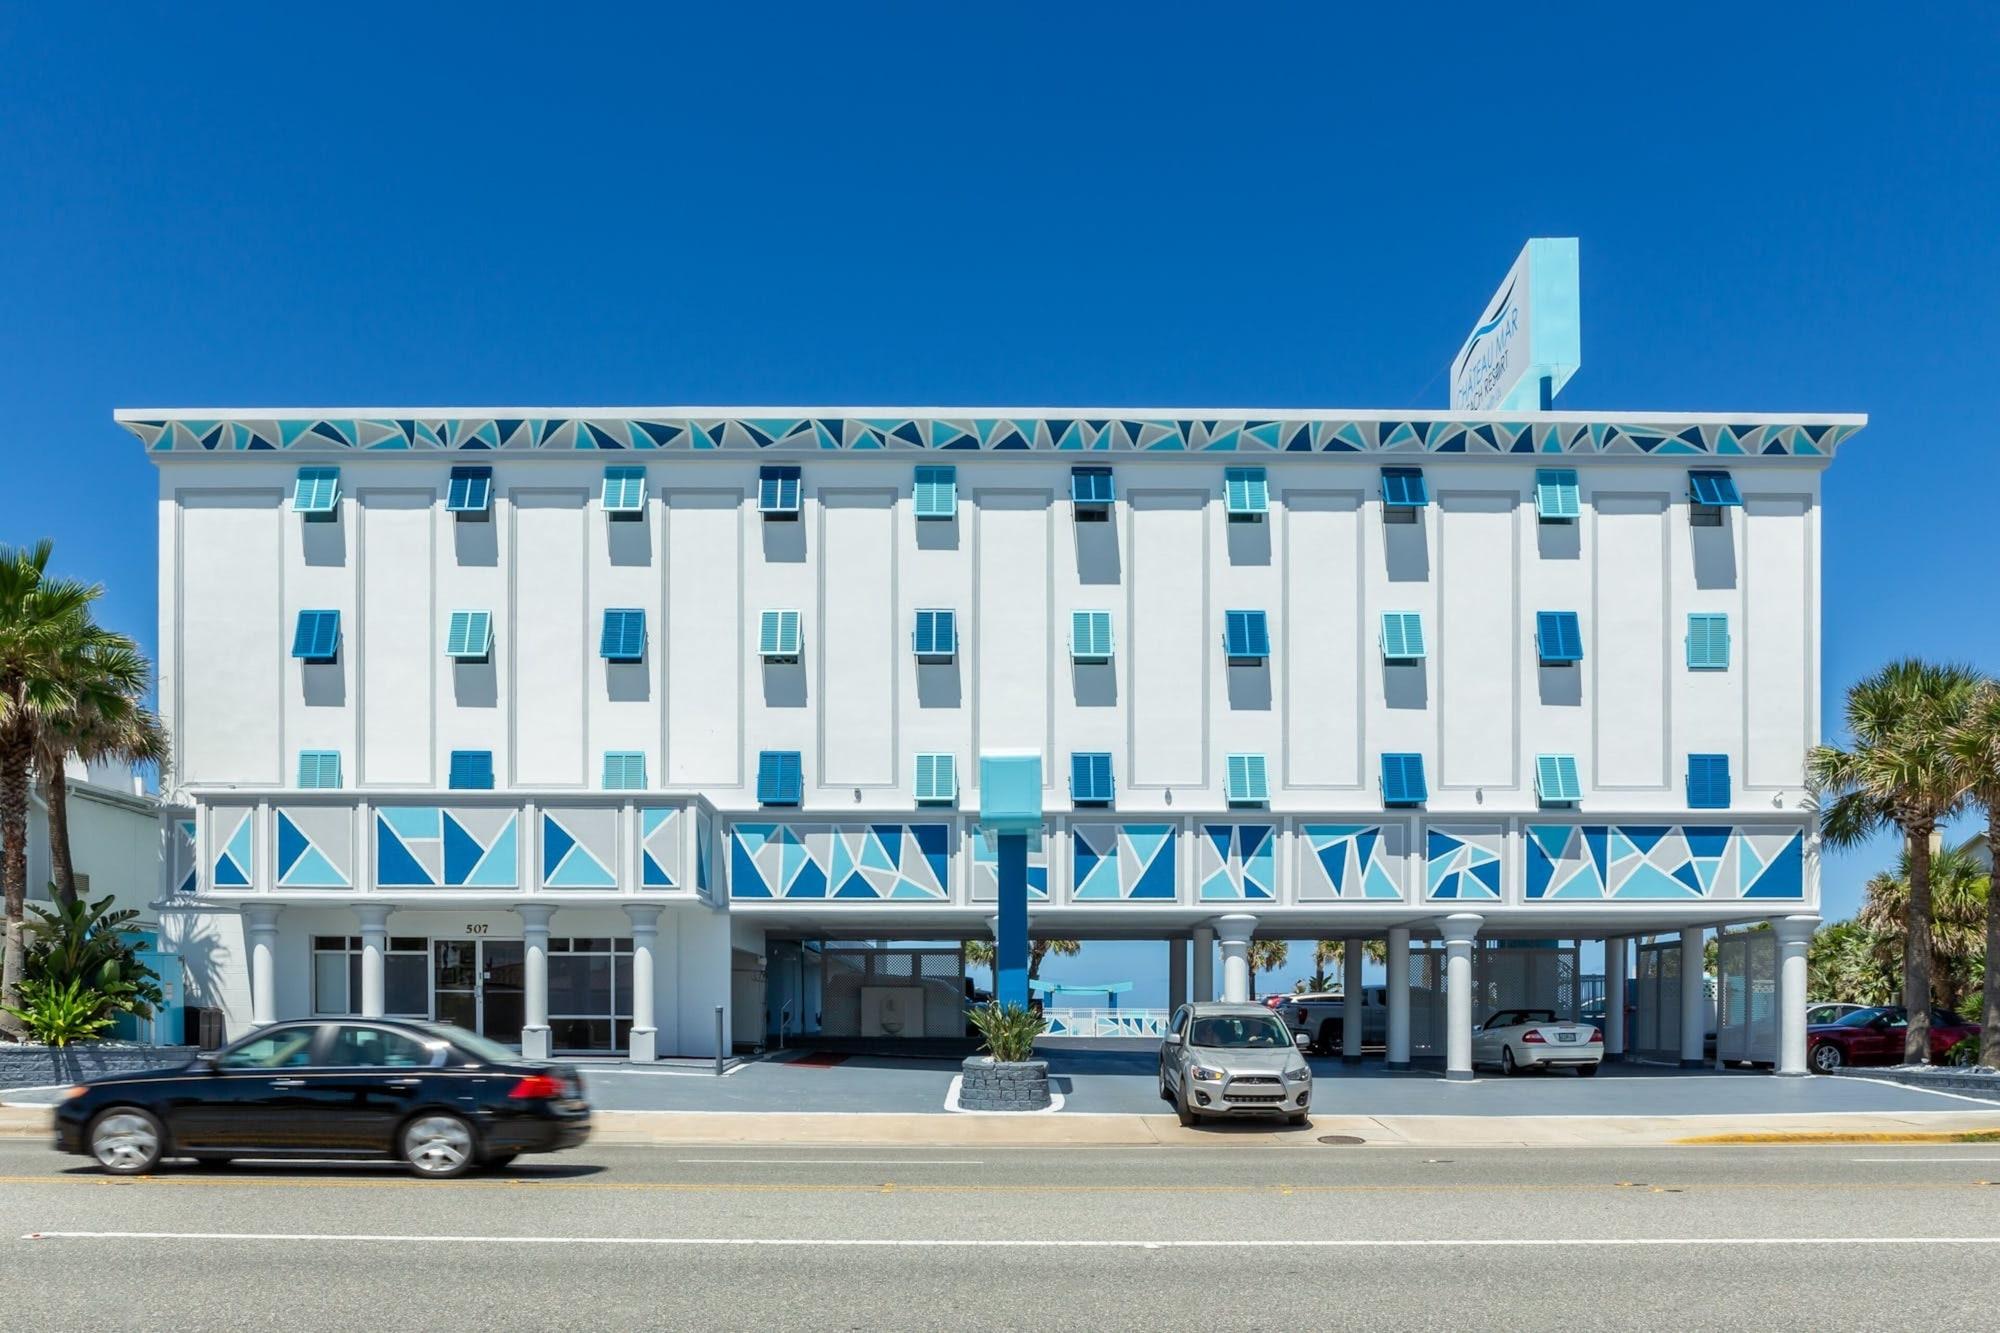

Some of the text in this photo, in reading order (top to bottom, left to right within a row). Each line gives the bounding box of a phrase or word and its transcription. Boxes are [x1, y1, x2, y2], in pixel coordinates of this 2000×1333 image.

[1496, 307, 1519, 358] MAR
[1485, 349, 1509, 396] RESORT
[466, 924, 488, 934] 507
